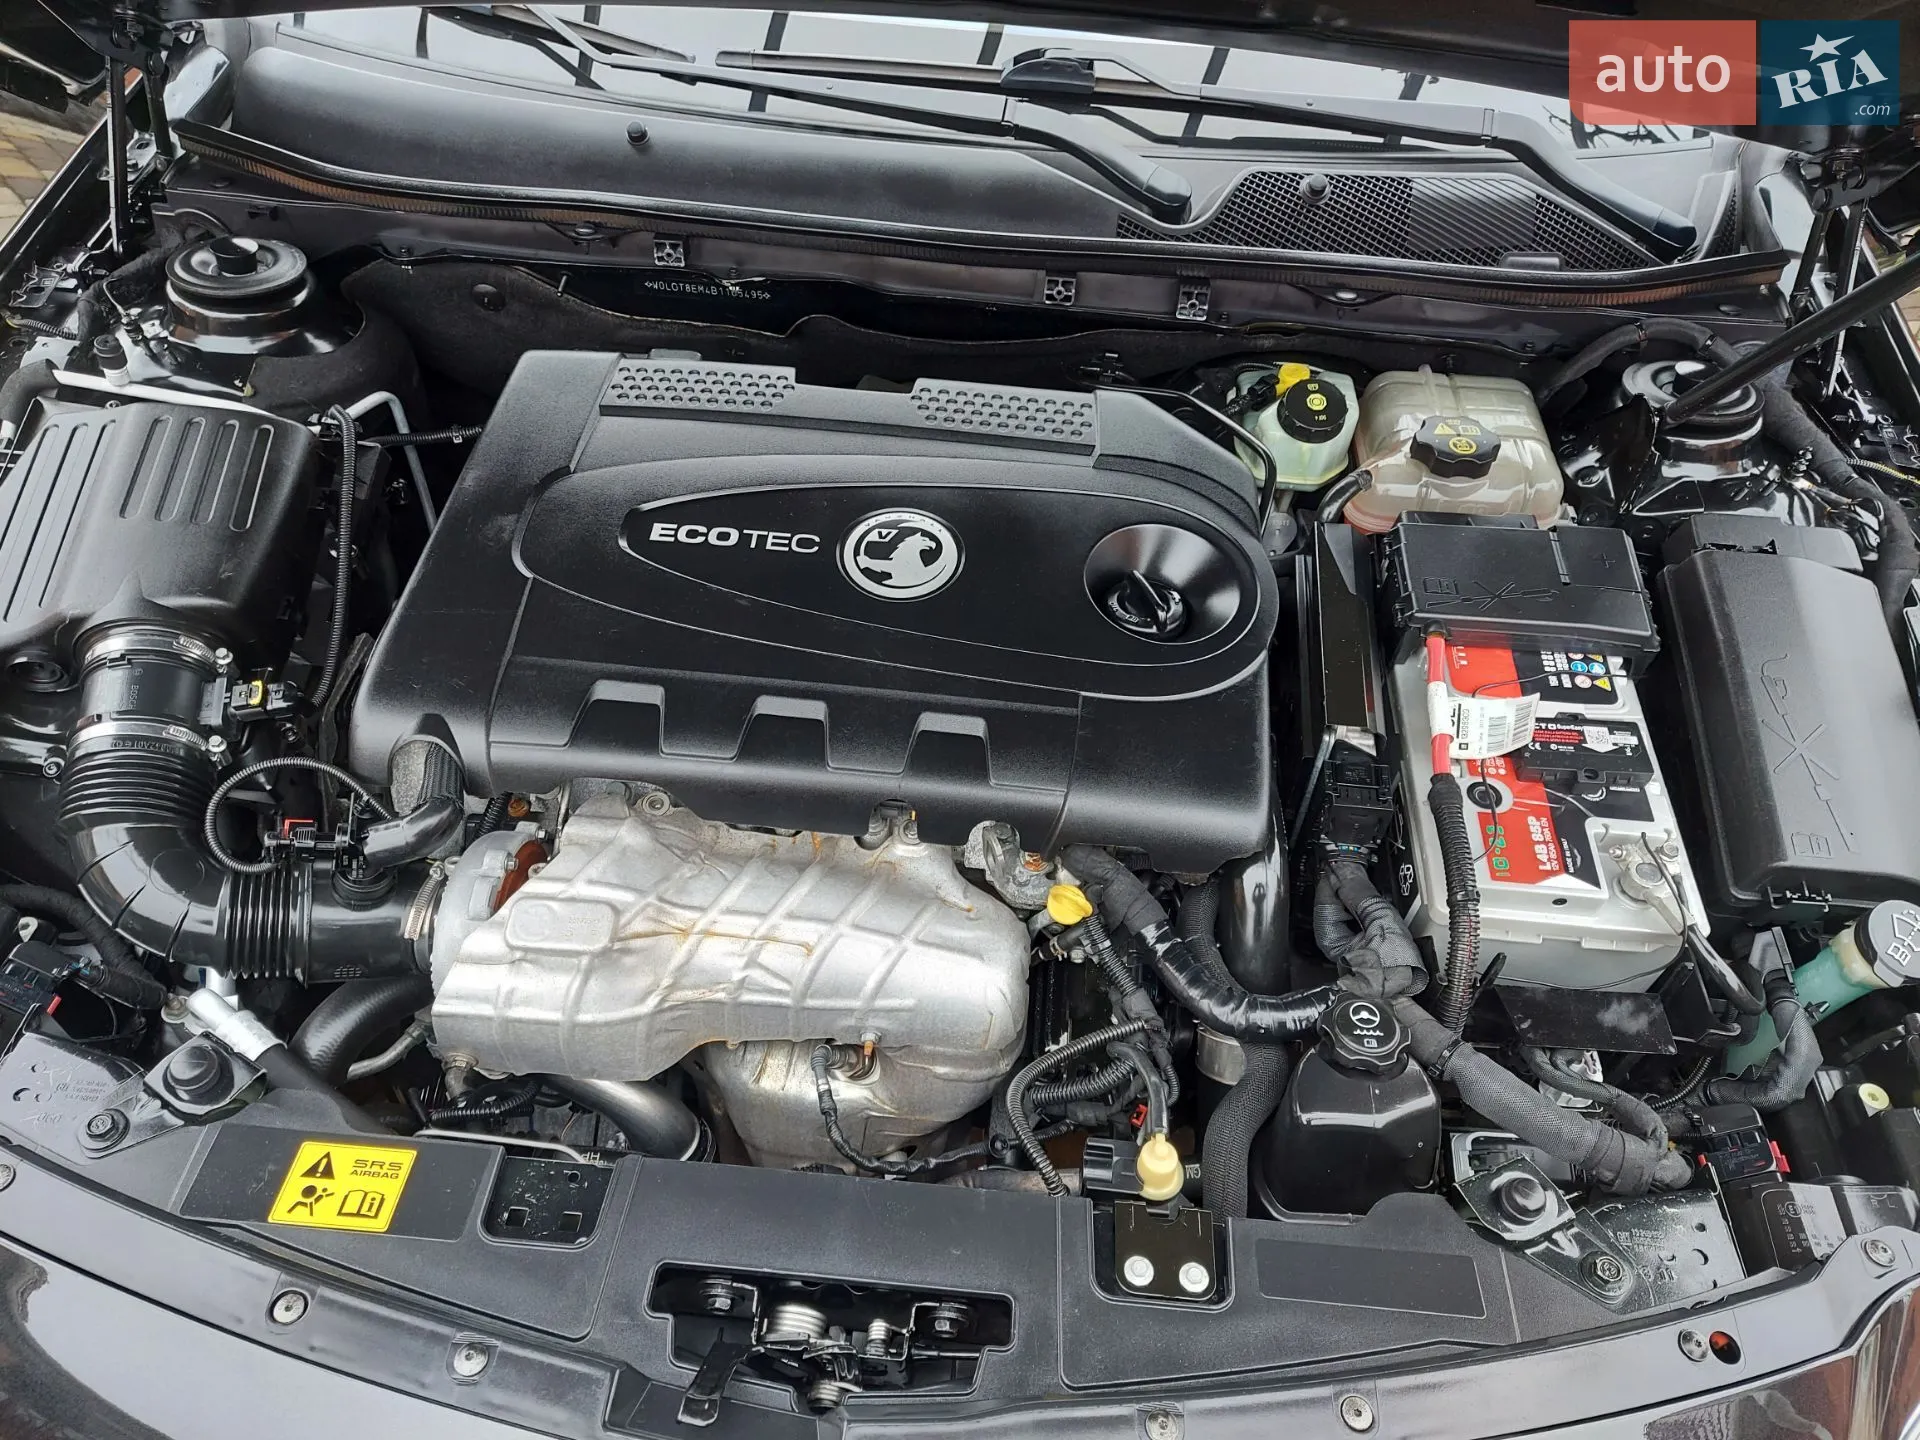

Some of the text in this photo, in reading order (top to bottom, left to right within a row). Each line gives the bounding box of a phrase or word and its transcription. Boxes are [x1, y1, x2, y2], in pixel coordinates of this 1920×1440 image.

[1527, 815, 1551, 871] L4B 85P
[352, 1159, 404, 1171] SRS
[350, 1169, 400, 1180] AIRBAG
